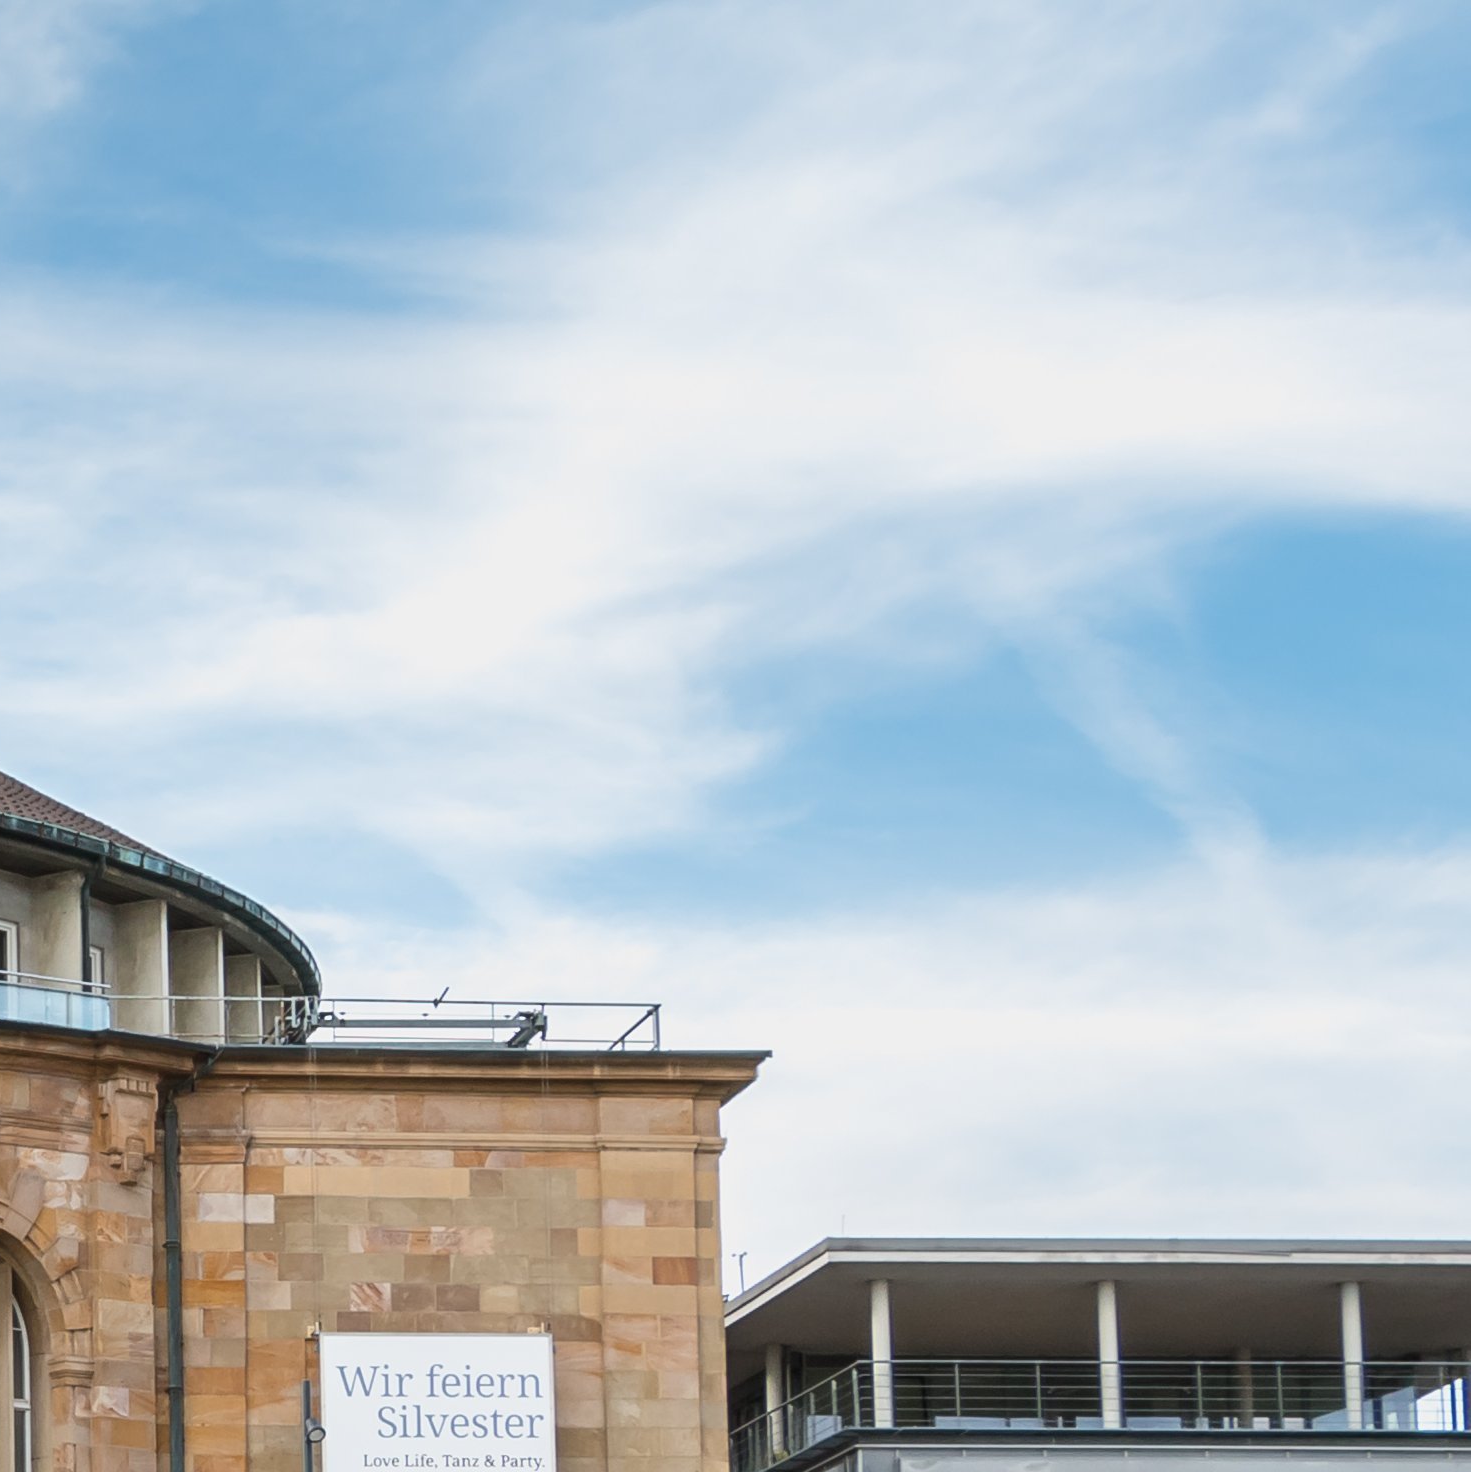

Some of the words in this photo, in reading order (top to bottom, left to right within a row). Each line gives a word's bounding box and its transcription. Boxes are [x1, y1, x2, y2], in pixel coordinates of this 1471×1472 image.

[336, 1363, 414, 1398] Wir
[426, 1363, 543, 1398] feiern
[377, 1404, 544, 1438] Silvester
[363, 1454, 400, 1468] Love
[404, 1454, 438, 1469] Life,
[442, 1454, 480, 1468] Tanz
[484, 1454, 496, 1468] &
[501, 1454, 545, 1471] Party.
